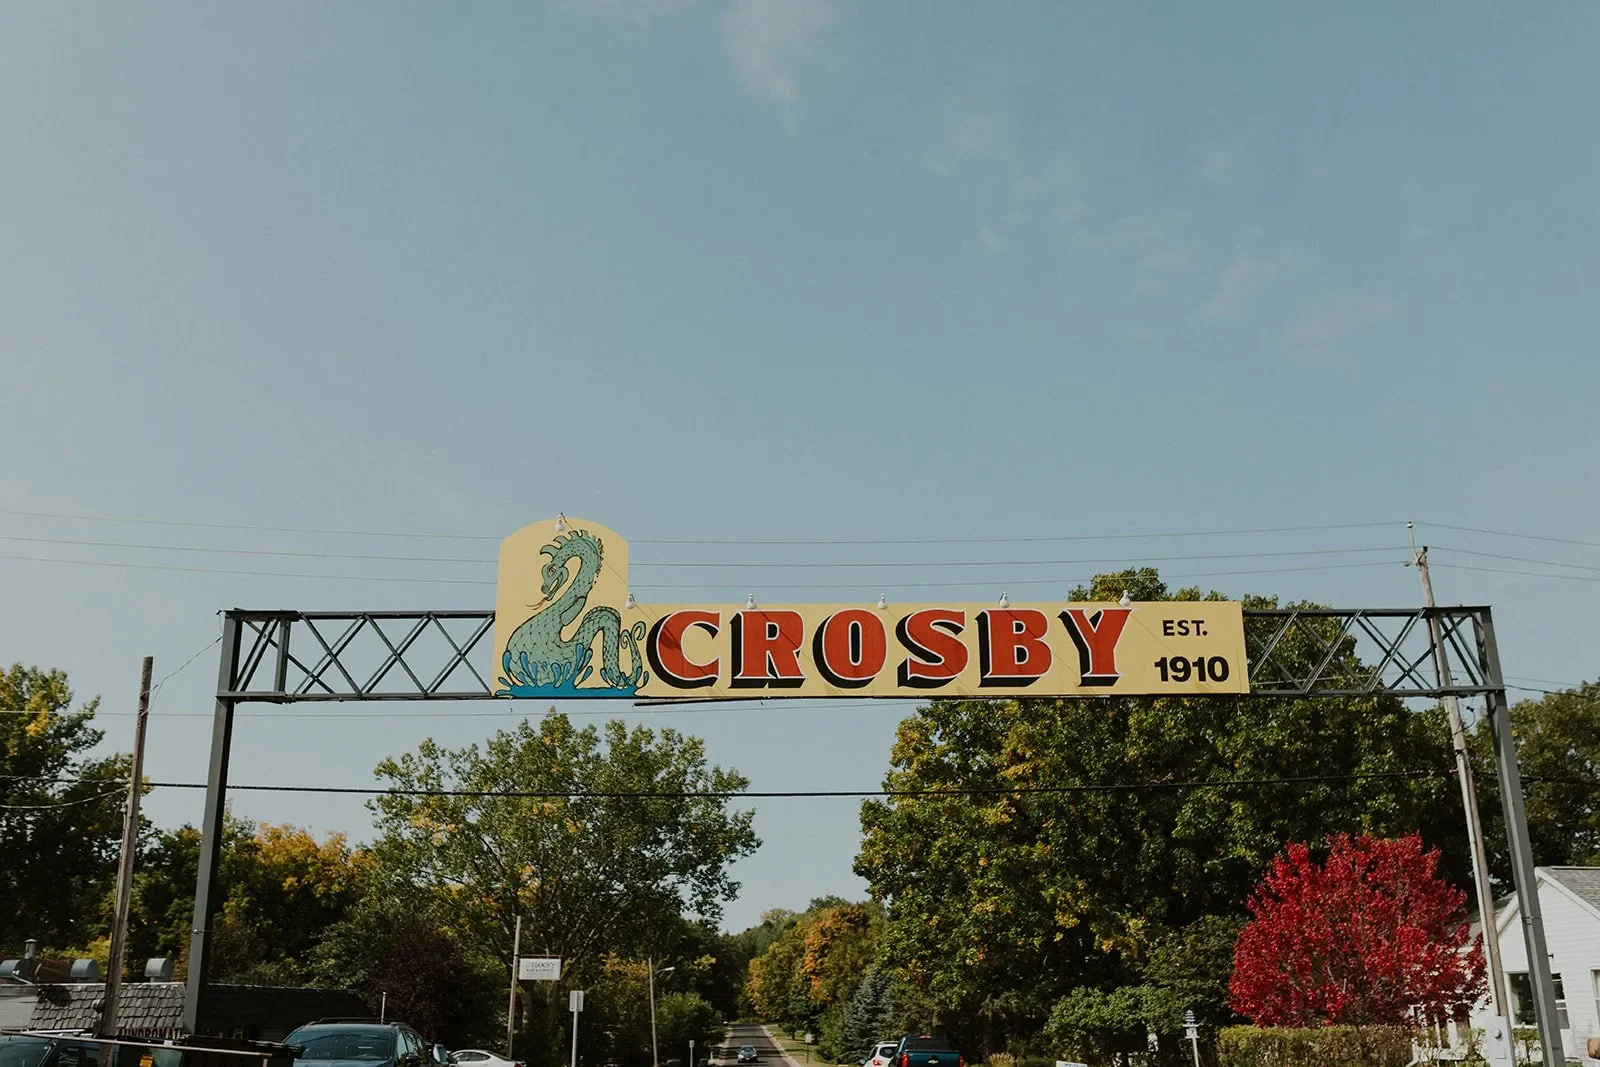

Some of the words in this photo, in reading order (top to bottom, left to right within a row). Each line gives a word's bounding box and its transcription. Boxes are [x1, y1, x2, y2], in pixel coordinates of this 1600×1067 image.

[1162, 619, 1208, 637] EST.
[646, 608, 1134, 689] CROSBY
[1154, 656, 1230, 682] 1910
